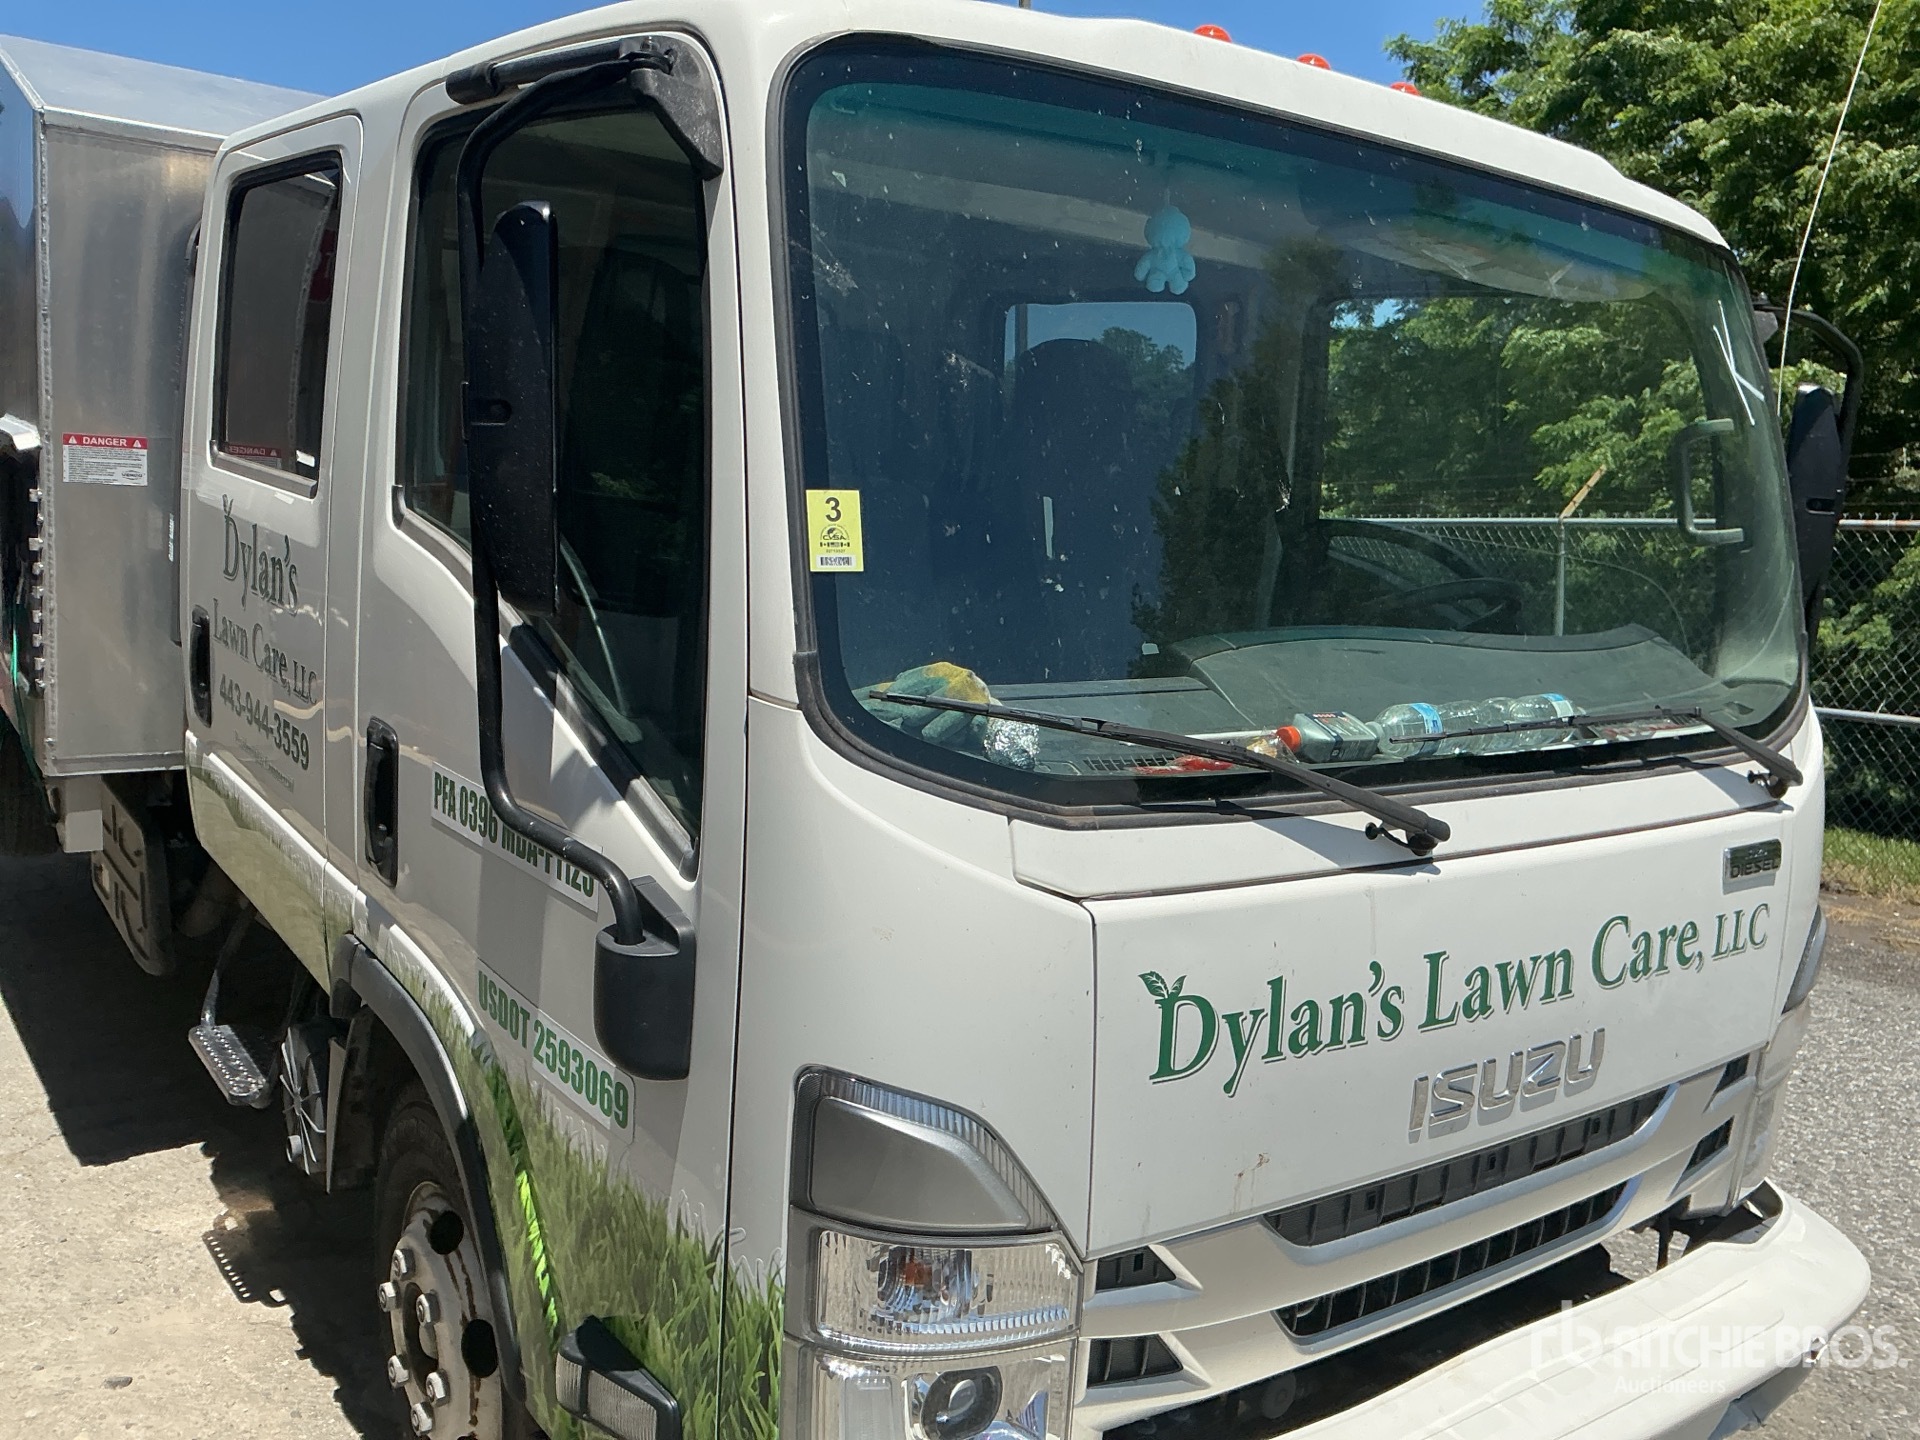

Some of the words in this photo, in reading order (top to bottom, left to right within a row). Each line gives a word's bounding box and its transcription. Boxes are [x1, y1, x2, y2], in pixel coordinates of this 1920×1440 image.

[82, 436, 127, 447] DANGER
[825, 497, 842, 522] 3
[222, 510, 299, 617] Dylan's
[213, 598, 249, 663] Lawn
[252, 623, 291, 696] Care,
[293, 660, 317, 704] LLC
[220, 674, 309, 770] 443-944-3559
[434, 771, 457, 821] PFA
[459, 785, 498, 844] 0396
[1730, 859, 1779, 879] DIESEL
[478, 970, 530, 1049] USDOT
[533, 1019, 629, 1129] 2593069
[1148, 961, 1404, 1098] Dylan's
[1418, 951, 1575, 1033] Lawn
[1592, 915, 1705, 989] Care,
[1712, 903, 1771, 961] LLC
[1408, 1028, 1606, 1132] ISUZU
